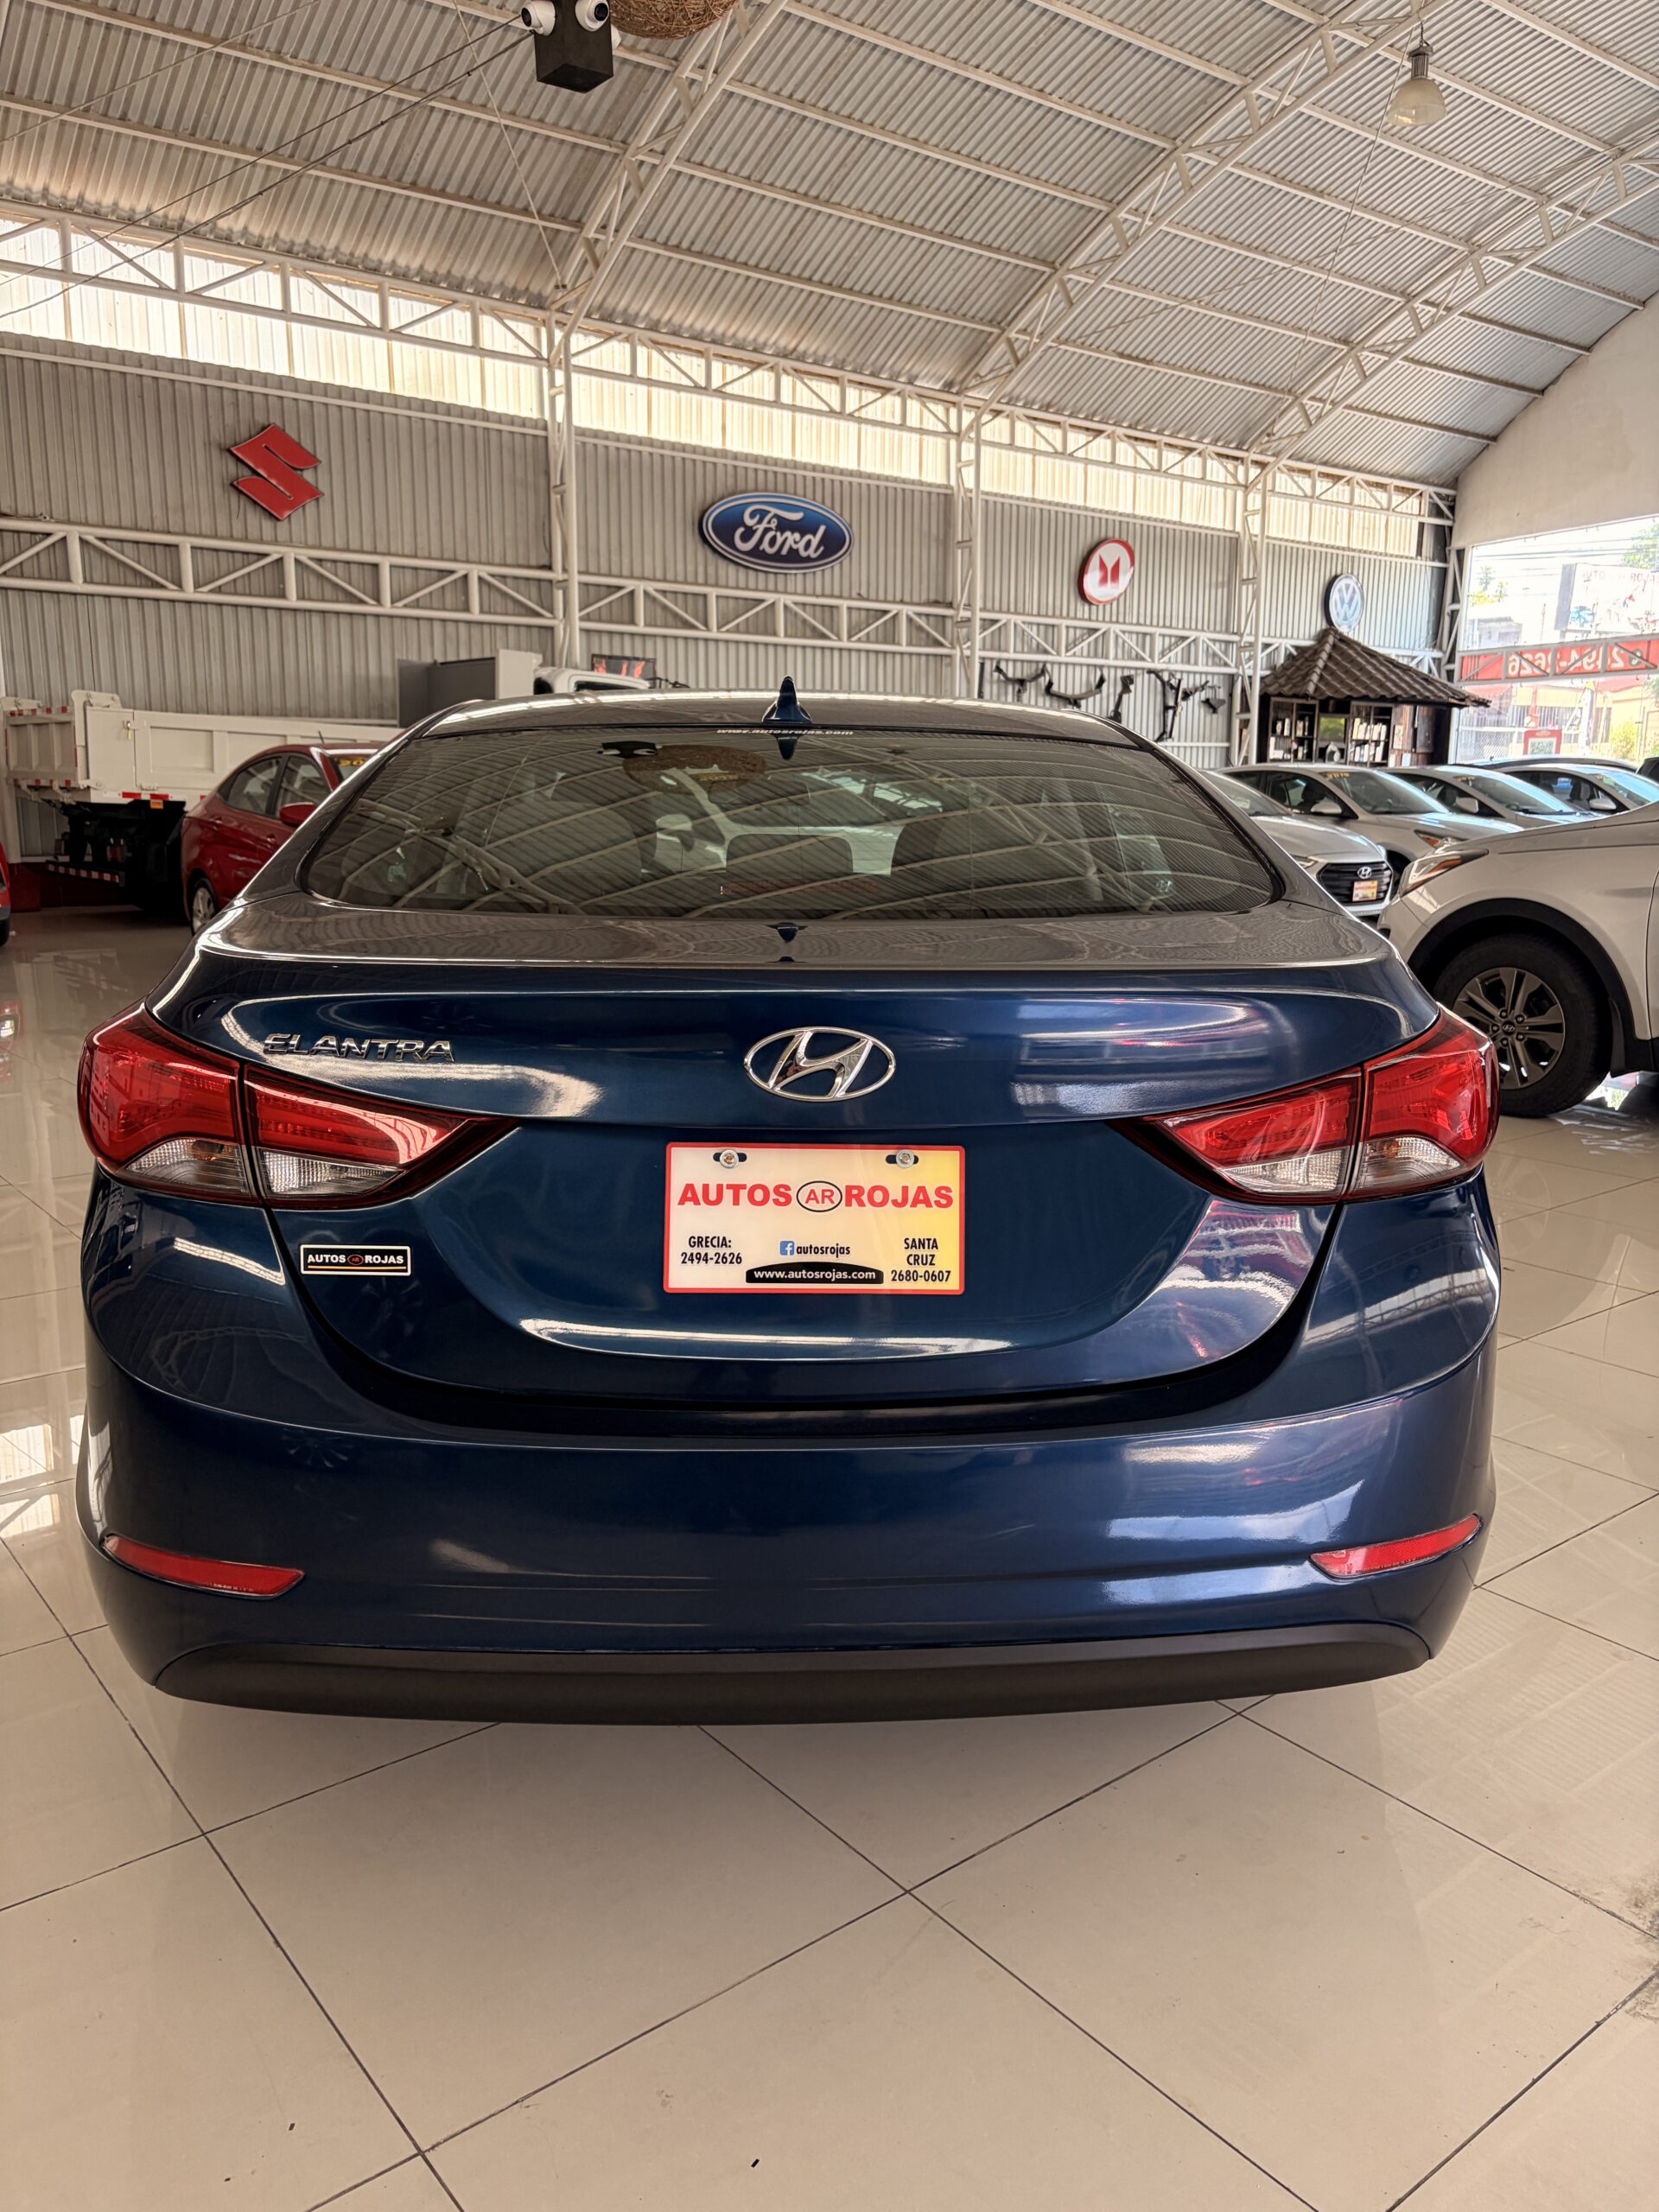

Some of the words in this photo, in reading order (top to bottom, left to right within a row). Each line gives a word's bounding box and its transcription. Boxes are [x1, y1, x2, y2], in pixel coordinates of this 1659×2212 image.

[734, 505, 826, 558] Ford
[263, 1033, 454, 1062] ELANTRA
[677, 1183, 792, 1207] AUTOS
[804, 1188, 835, 1205] AR
[845, 1185, 953, 1209] ROJAS
[688, 1236, 732, 1249] GRECIA:
[904, 1237, 938, 1250] SANTA
[796, 1243, 850, 1258] autosrojas
[308, 1254, 346, 1263] AUTOS
[365, 1255, 404, 1264] ROJAS
[681, 1252, 742, 1264] 2494-2626
[906, 1254, 936, 1266] CRUZ
[753, 1268, 876, 1281] www.autosrojas.com
[891, 1269, 951, 1282] 2680-0607
